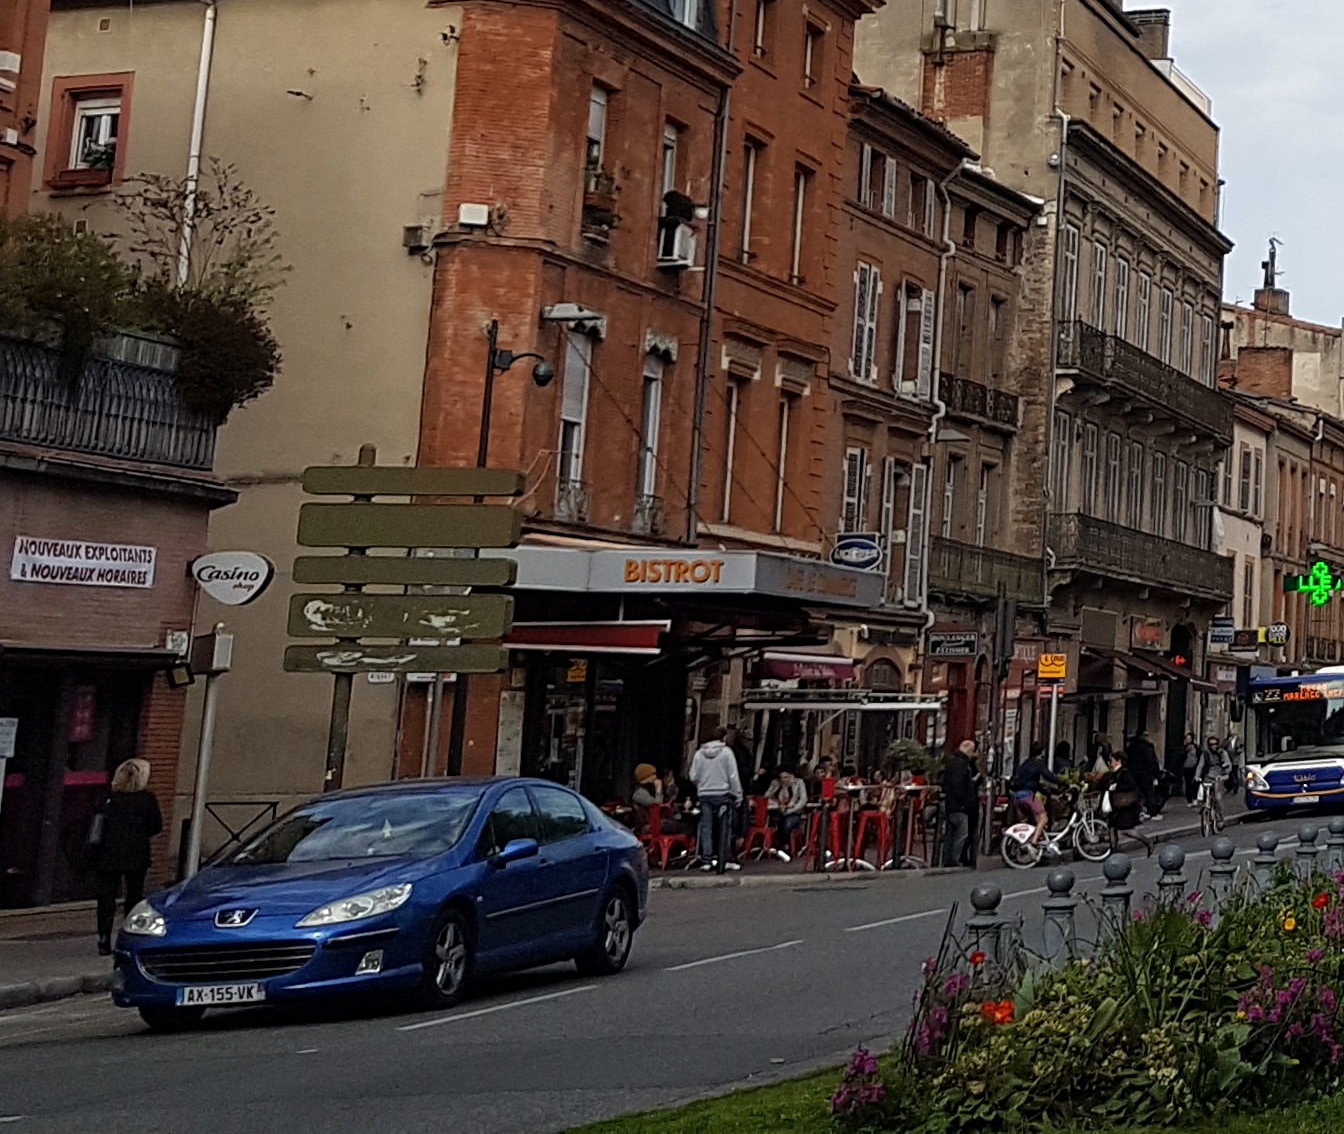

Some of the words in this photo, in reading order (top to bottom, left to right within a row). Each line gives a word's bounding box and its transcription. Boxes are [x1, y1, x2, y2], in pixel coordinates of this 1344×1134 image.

[18, 539, 82, 559] NOUVEAUX
[85, 545, 153, 564] EXPLOITANTS
[30, 563, 94, 582] NOUVEAUX
[96, 568, 147, 585] HORAIRES
[196, 565, 260, 583] Casino
[623, 559, 725, 584] BISTROT
[232, 582, 254, 593] shop
[187, 985, 255, 1003] AX-155-VK
